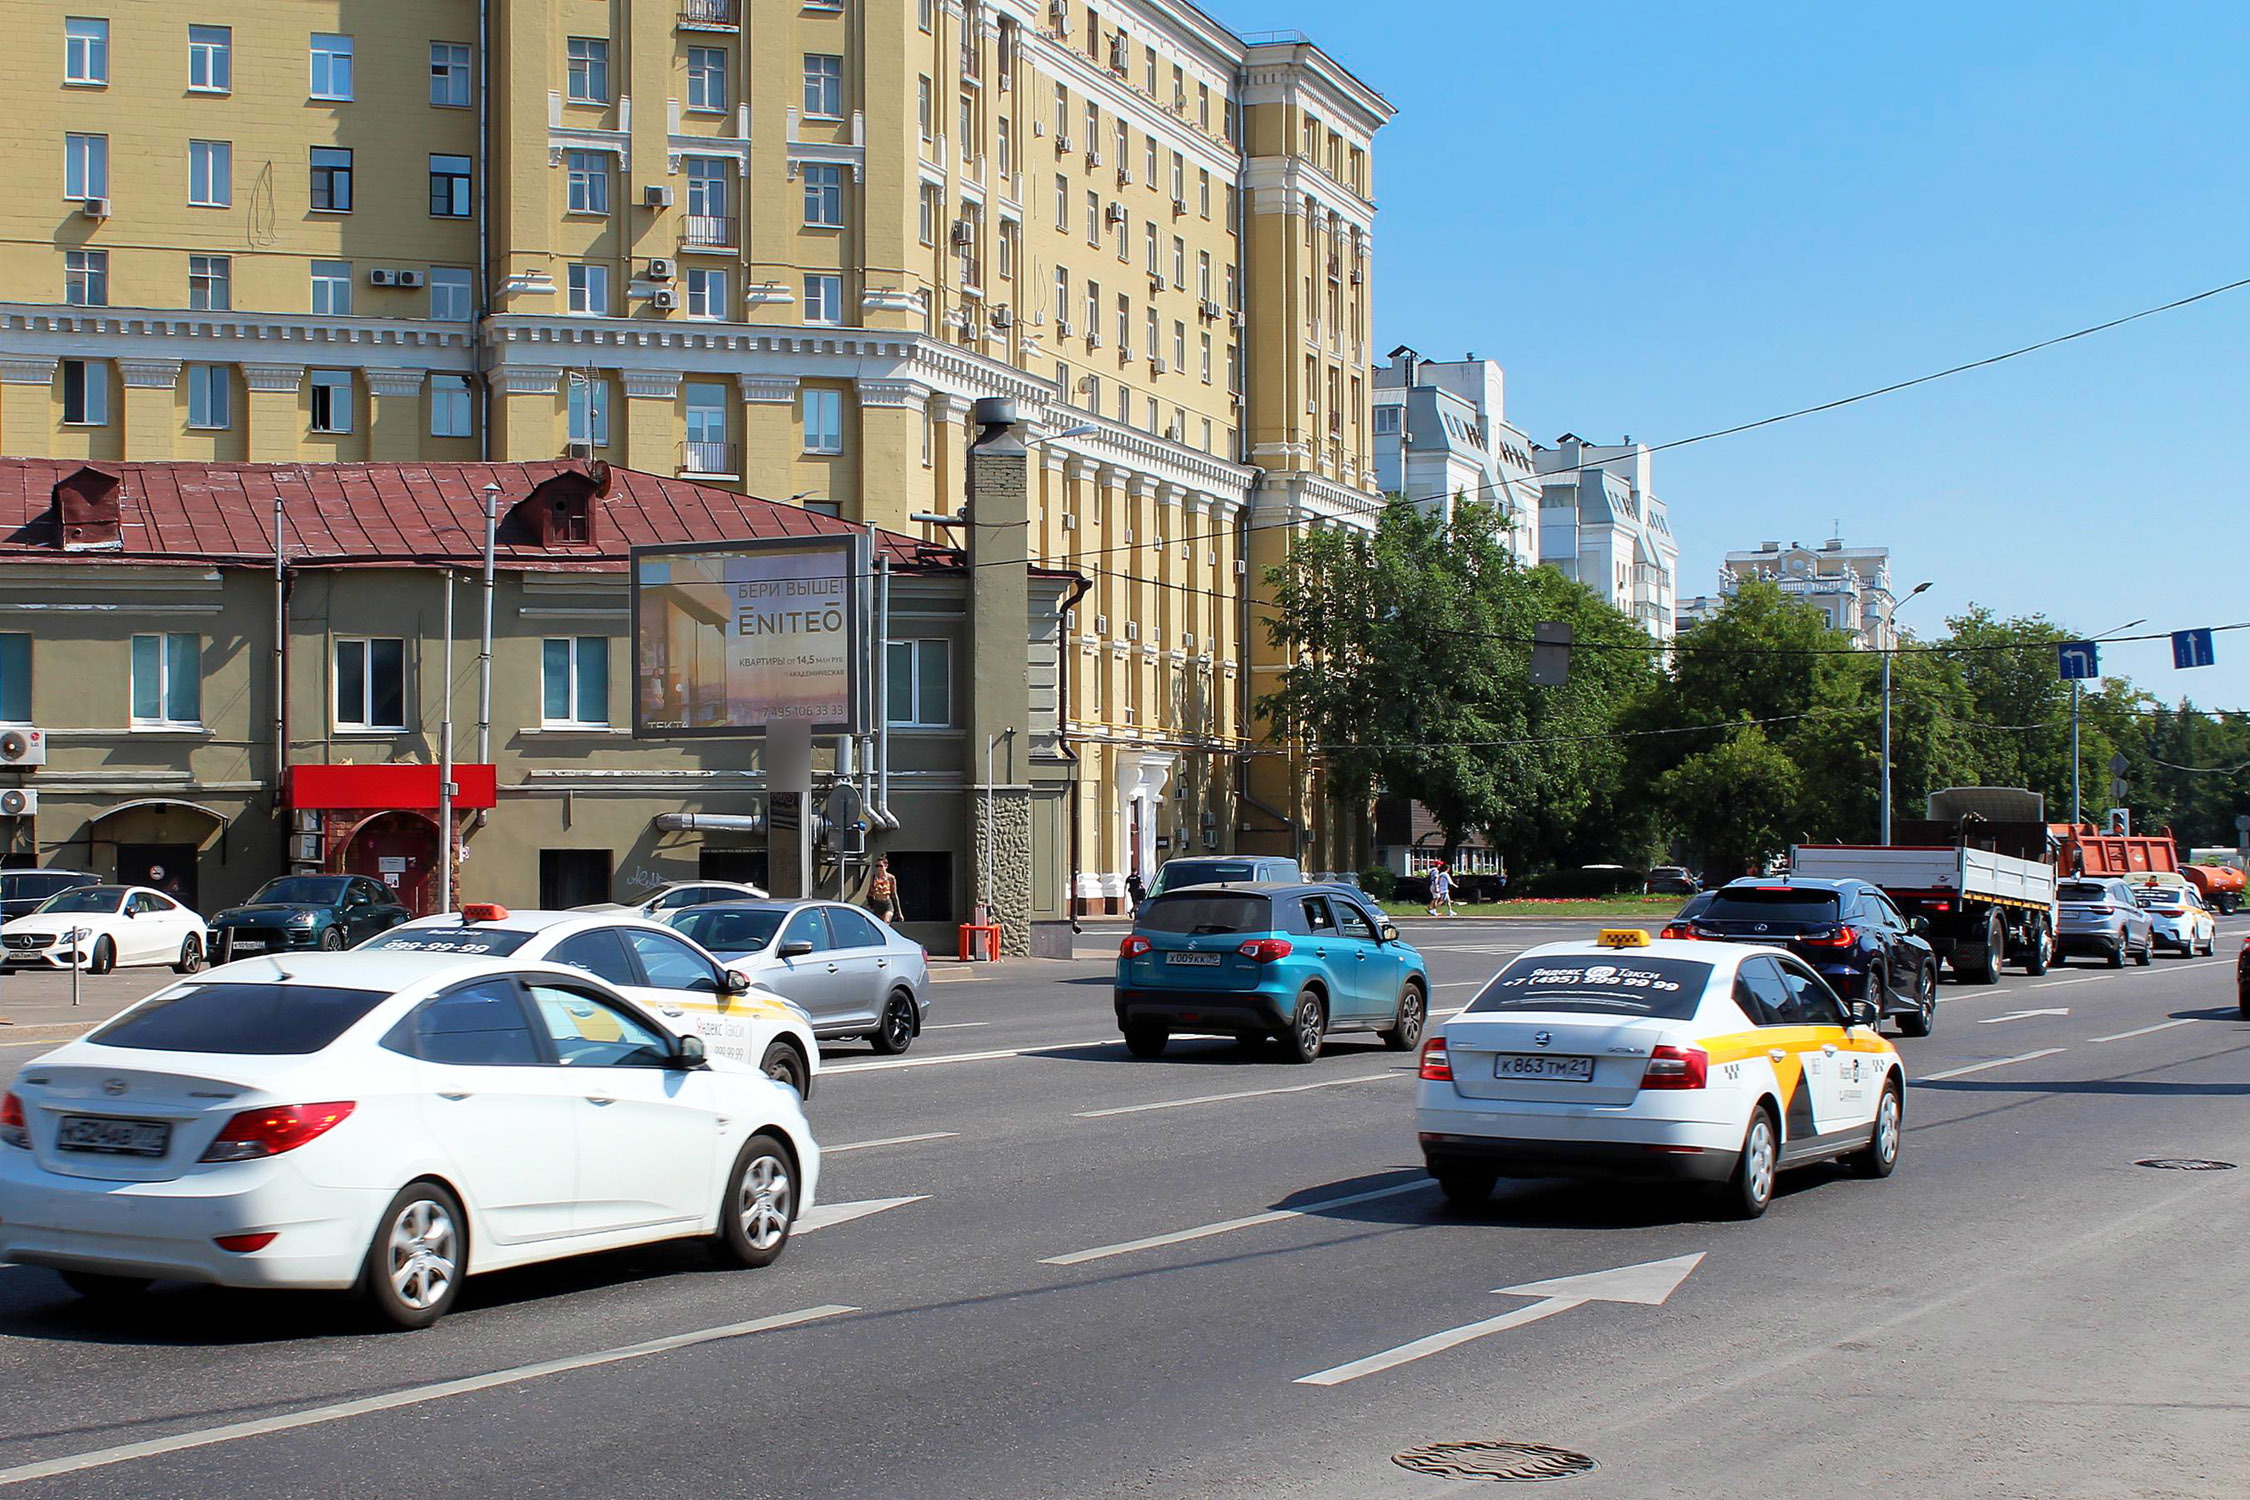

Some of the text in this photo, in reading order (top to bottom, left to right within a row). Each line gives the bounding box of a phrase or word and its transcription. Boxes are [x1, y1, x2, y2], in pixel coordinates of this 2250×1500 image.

[738, 579, 844, 599] БЕРИ ВЫШЕ!
[739, 657, 786, 667] КВАРТИРЫ
[796, 655, 815, 666] 14,5
[771, 705, 791, 717] 495
[794, 705, 813, 717] 106
[815, 704, 828, 716] 33
[831, 704, 844, 716] 33
[381, 941, 490, 954] 999-99-99
[1530, 968, 1585, 978] Яндекс
[1617, 968, 1661, 980] Такси
[1502, 975, 1680, 991] +7 (495) 999 99 99
